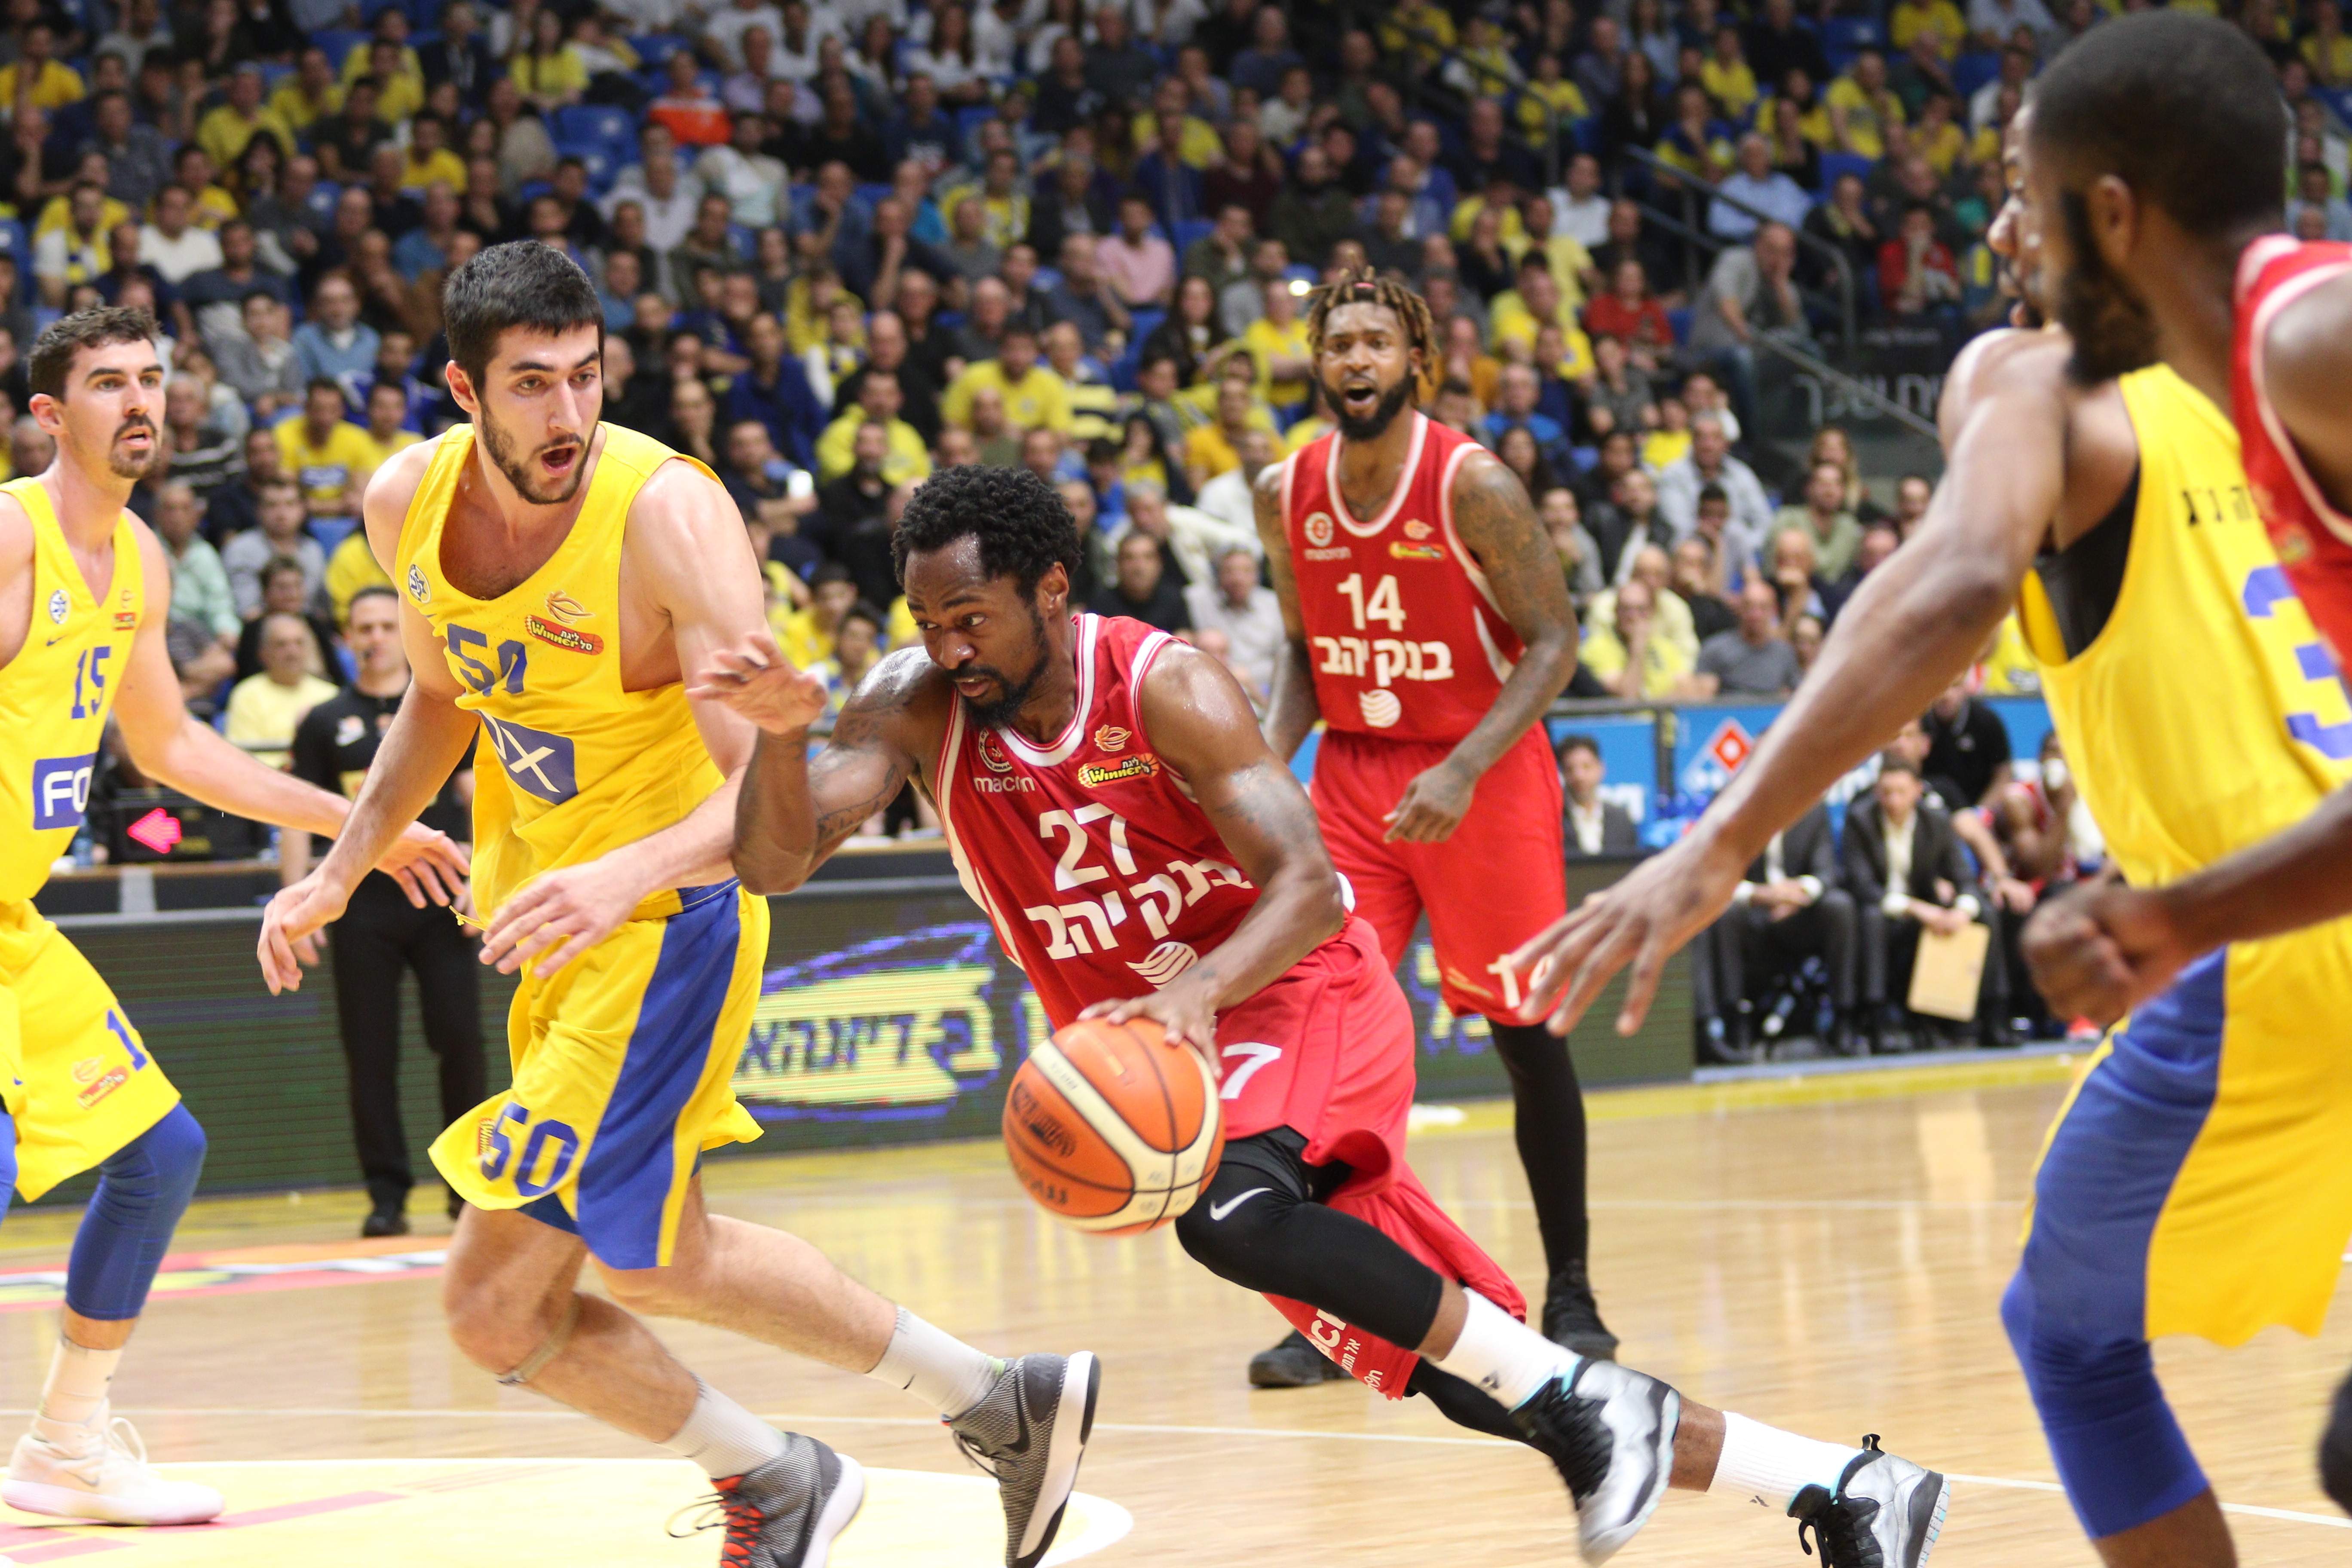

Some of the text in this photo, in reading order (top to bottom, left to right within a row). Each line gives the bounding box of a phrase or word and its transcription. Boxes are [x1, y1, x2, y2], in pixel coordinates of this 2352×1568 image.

[1337, 573, 1407, 632] 14
[531, 621, 579, 648] Winner
[560, 630, 580, 641] ליגת
[580, 640, 593, 651] סל
[71, 646, 111, 719] 15
[1088, 766, 1142, 783] Winner
[1039, 802, 1137, 891] 27
[481, 1101, 579, 1197] 50
